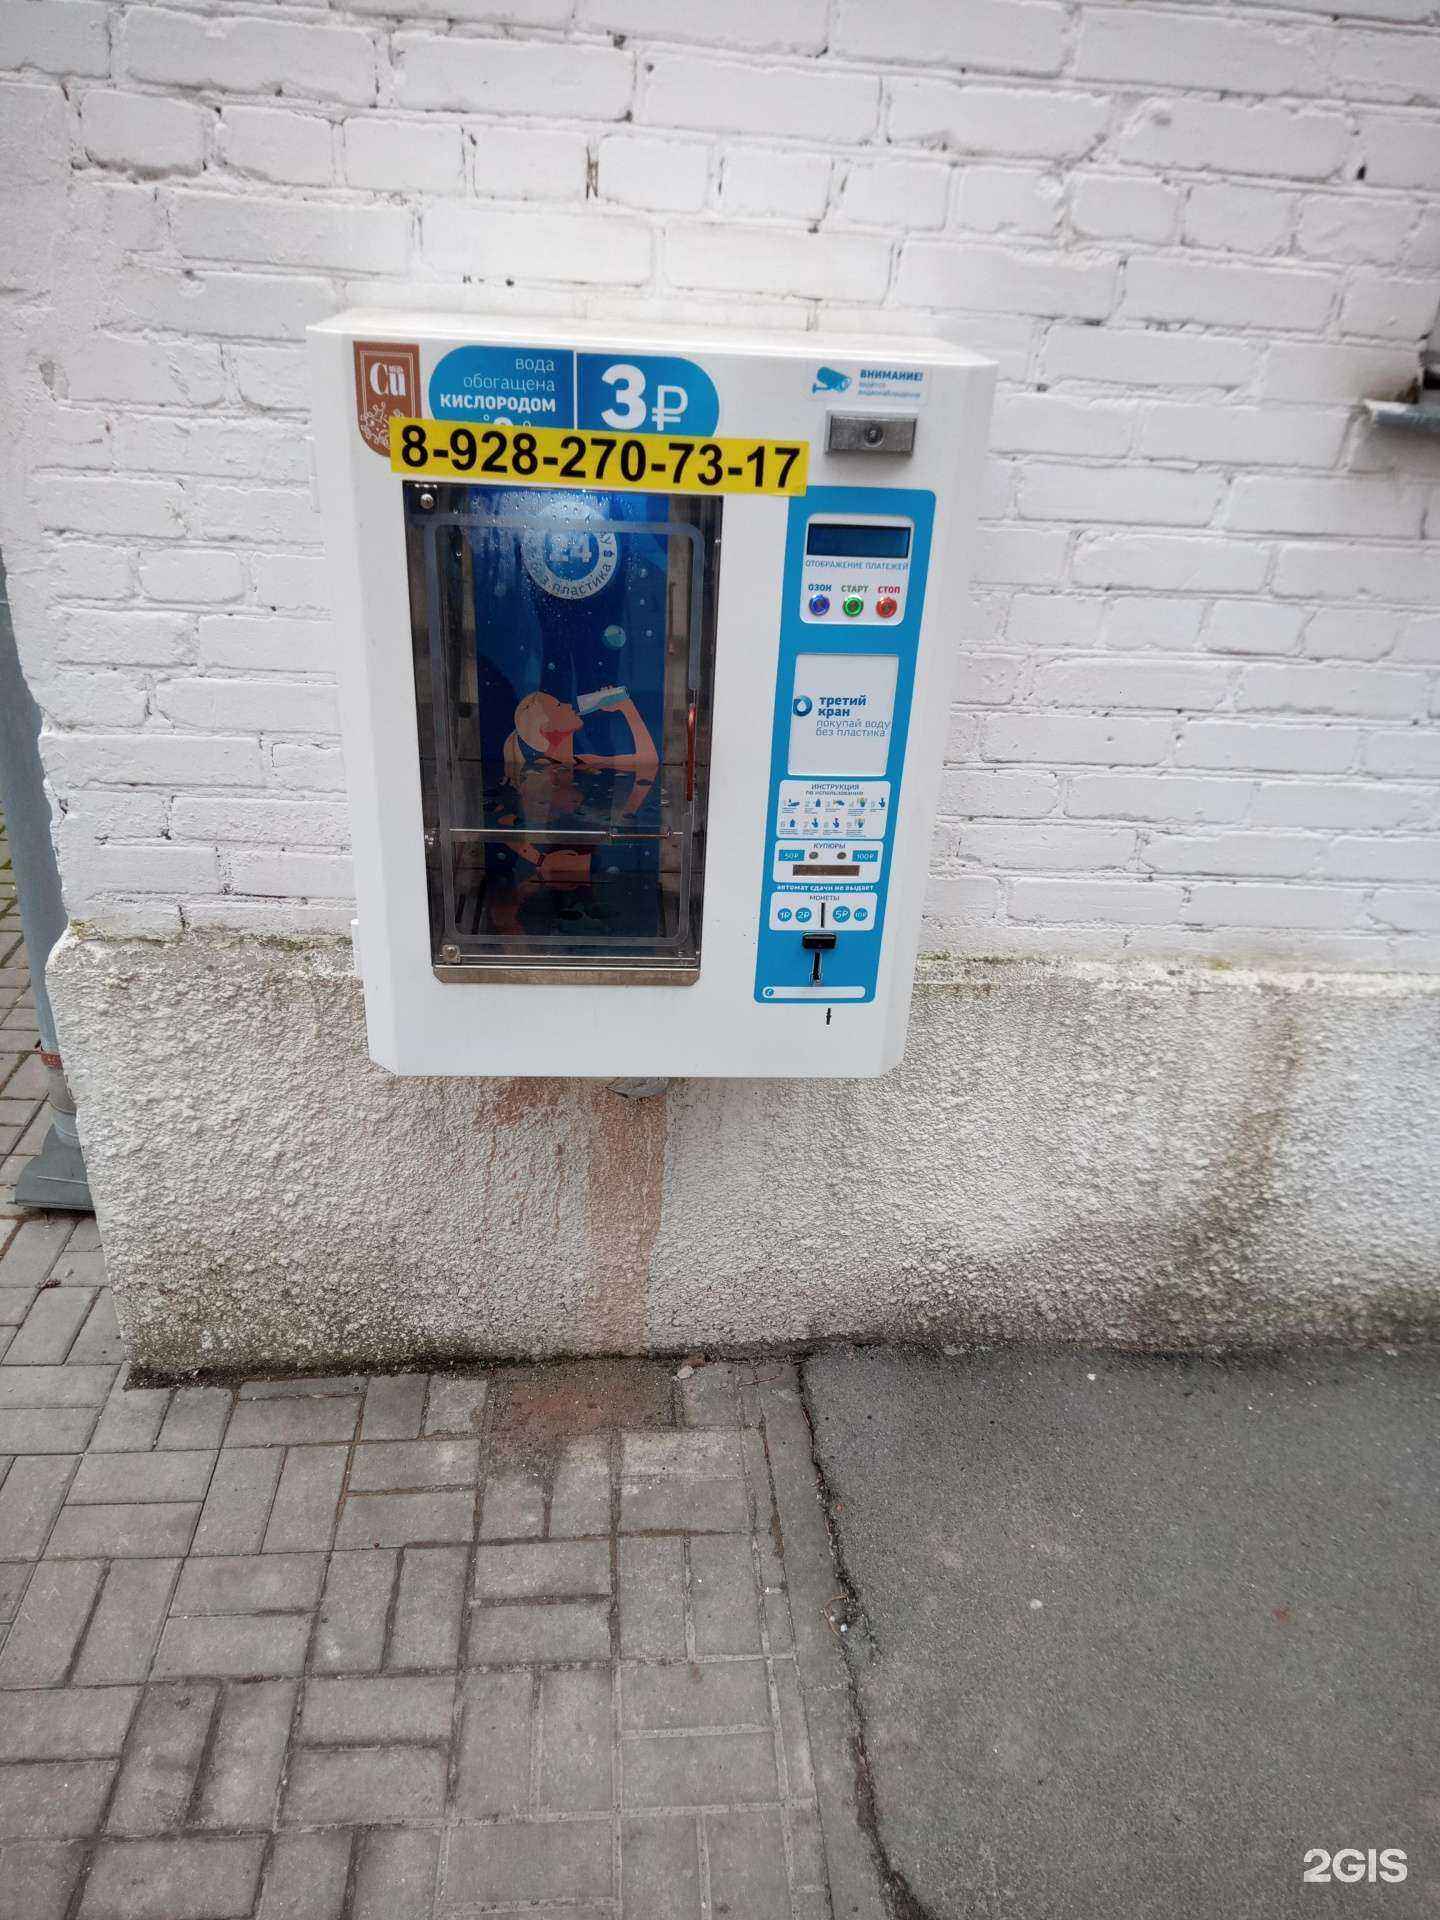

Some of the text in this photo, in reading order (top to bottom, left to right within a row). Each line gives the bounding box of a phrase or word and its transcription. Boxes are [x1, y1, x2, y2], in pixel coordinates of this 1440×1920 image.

[515, 358, 555, 374] вода
[860, 368, 924, 381] ВНИМАНИЕ!
[463, 374, 555, 393] обогащена
[440, 394, 556, 413] КИСЛОРОДОМ
[401, 424, 800, 489] 8-928-270-73-17
[805, 559, 909, 570] ОТОБРАЖЕНИЕ ПЛАТЕЖЕЙ
[808, 583, 832, 592] ОЗОН
[841, 584, 869, 593] СТАРТ
[877, 585, 901, 594] СТОП
[819, 694, 867, 708] третий
[817, 707, 851, 718] кран
[816, 718, 892, 730] покупай воду
[815, 726, 886, 737] без пластика
